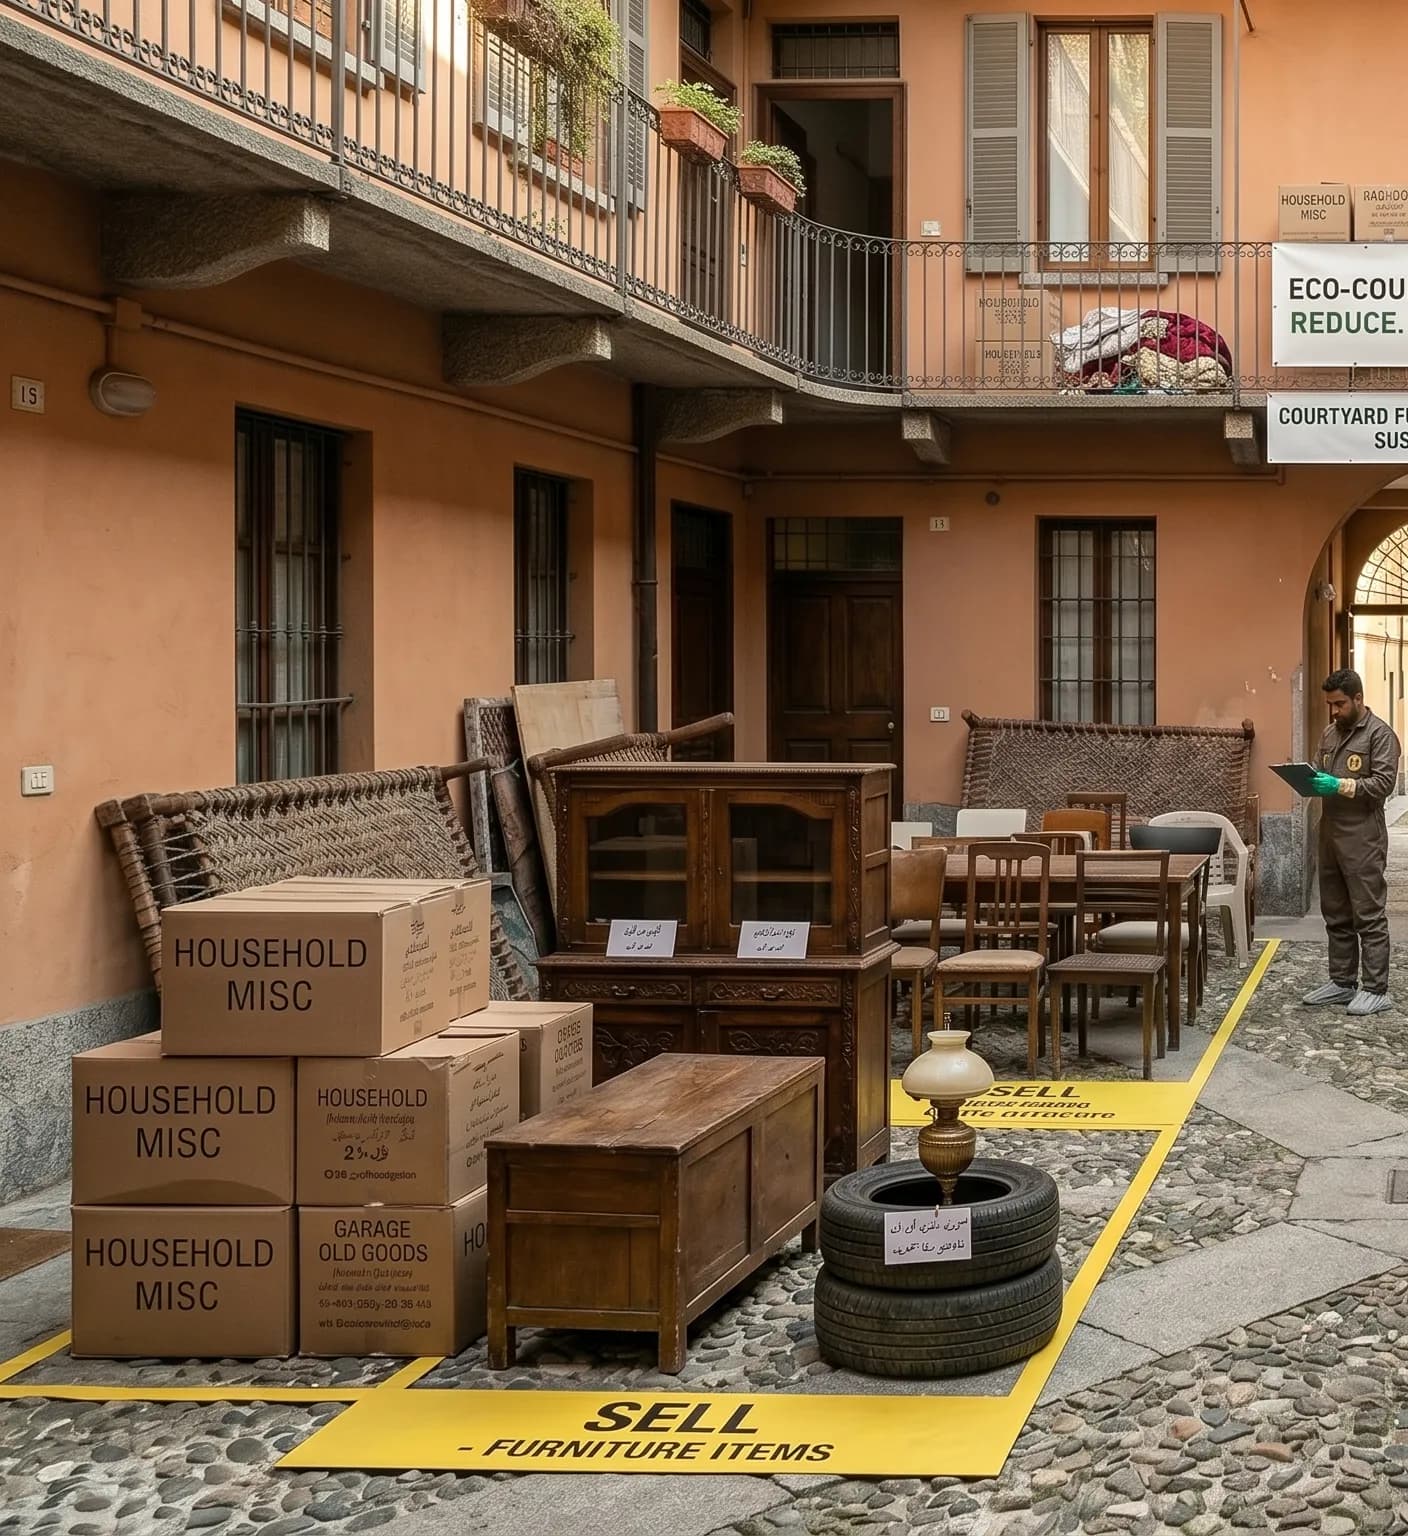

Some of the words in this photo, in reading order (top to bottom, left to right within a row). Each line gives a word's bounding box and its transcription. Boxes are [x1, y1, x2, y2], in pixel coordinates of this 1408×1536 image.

[1281, 194, 1346, 206] HOUSEHOLD
[1301, 209, 1327, 221] MISC
[1290, 311, 1404, 334] REDUCE.
[1278, 406, 1389, 426] COURTYARD
[174, 936, 368, 969] HOUSEHOLD
[226, 979, 314, 1012] MISC
[84, 1084, 277, 1116] HOUSEHOLD
[317, 1087, 428, 1107] HOUSEHOLD
[986, 1085, 1082, 1099] SELL
[135, 1126, 222, 1159] MISC
[334, 1219, 411, 1238] GARAGE
[85, 1237, 275, 1269] HOUSEHOLD
[319, 1243, 356, 1262] OLD
[362, 1243, 429, 1262] GOODS
[135, 1279, 219, 1312] MISC
[584, 1401, 760, 1435] SELL
[482, 1439, 704, 1462] FURNITURE
[708, 1440, 835, 1463] ITEMS
